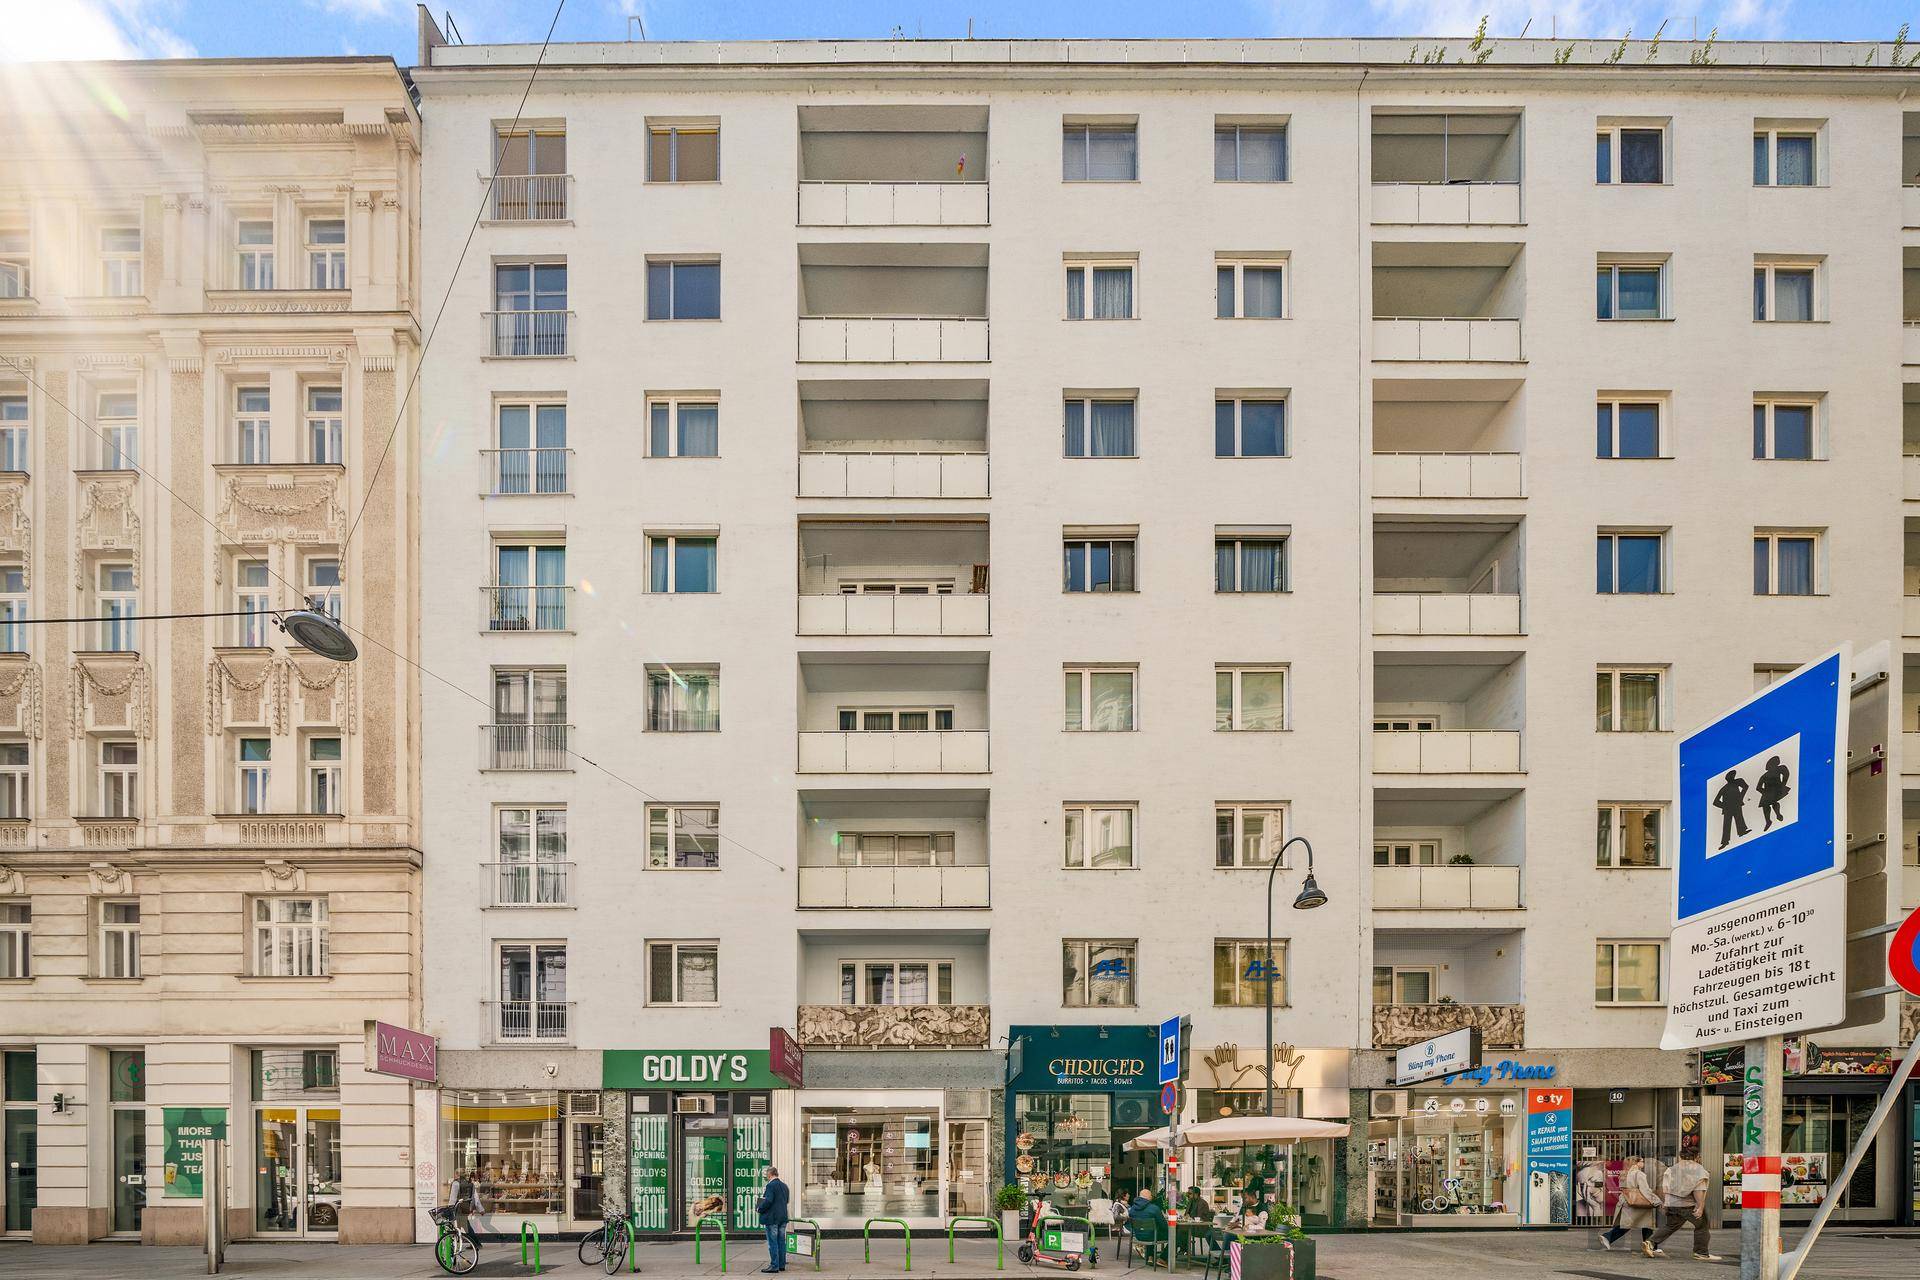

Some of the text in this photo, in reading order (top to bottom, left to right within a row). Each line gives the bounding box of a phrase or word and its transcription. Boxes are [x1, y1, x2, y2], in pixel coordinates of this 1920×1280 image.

[1706, 900, 1796, 936] ausgenommen
[1691, 937, 1730, 955] Mo.-Sa.
[1767, 925, 1775, 933] v.
[1714, 936, 1785, 962] Zufahrt zur
[1699, 944, 1805, 980] Ladetätigkeit mit
[1693, 972, 1760, 996] Fahrzeugen
[1765, 966, 1784, 981] bis
[1673, 970, 1836, 1015] höchstzul. Gesamtgewicht
[1708, 999, 1789, 1023] und Taxi zum
[1695, 1027, 1721, 1039] Aus-
[1735, 1011, 1803, 1031] Einsteigen
[380, 1032, 433, 1065] MAX
[1435, 1052, 1456, 1064] Phone
[1048, 1058, 1145, 1076] CHRUGER
[1496, 1060, 1556, 1080] Phone
[1057, 1077, 1133, 1086] BURRITOS TACOS BOWLS
[1612, 1092, 1623, 1100] 10
[178, 1126, 212, 1136] MORE
[1537, 1126, 1557, 1135] REPAIR
[178, 1139, 204, 1149] THA
[1531, 1134, 1569, 1146] SMARTPHONE
[181, 1152, 204, 1161] JUS
[634, 1151, 666, 1160] OPENING
[736, 1151, 767, 1160] OPENING
[634, 1186, 666, 1195] OPENING
[1048, 1234, 1057, 1247] P
